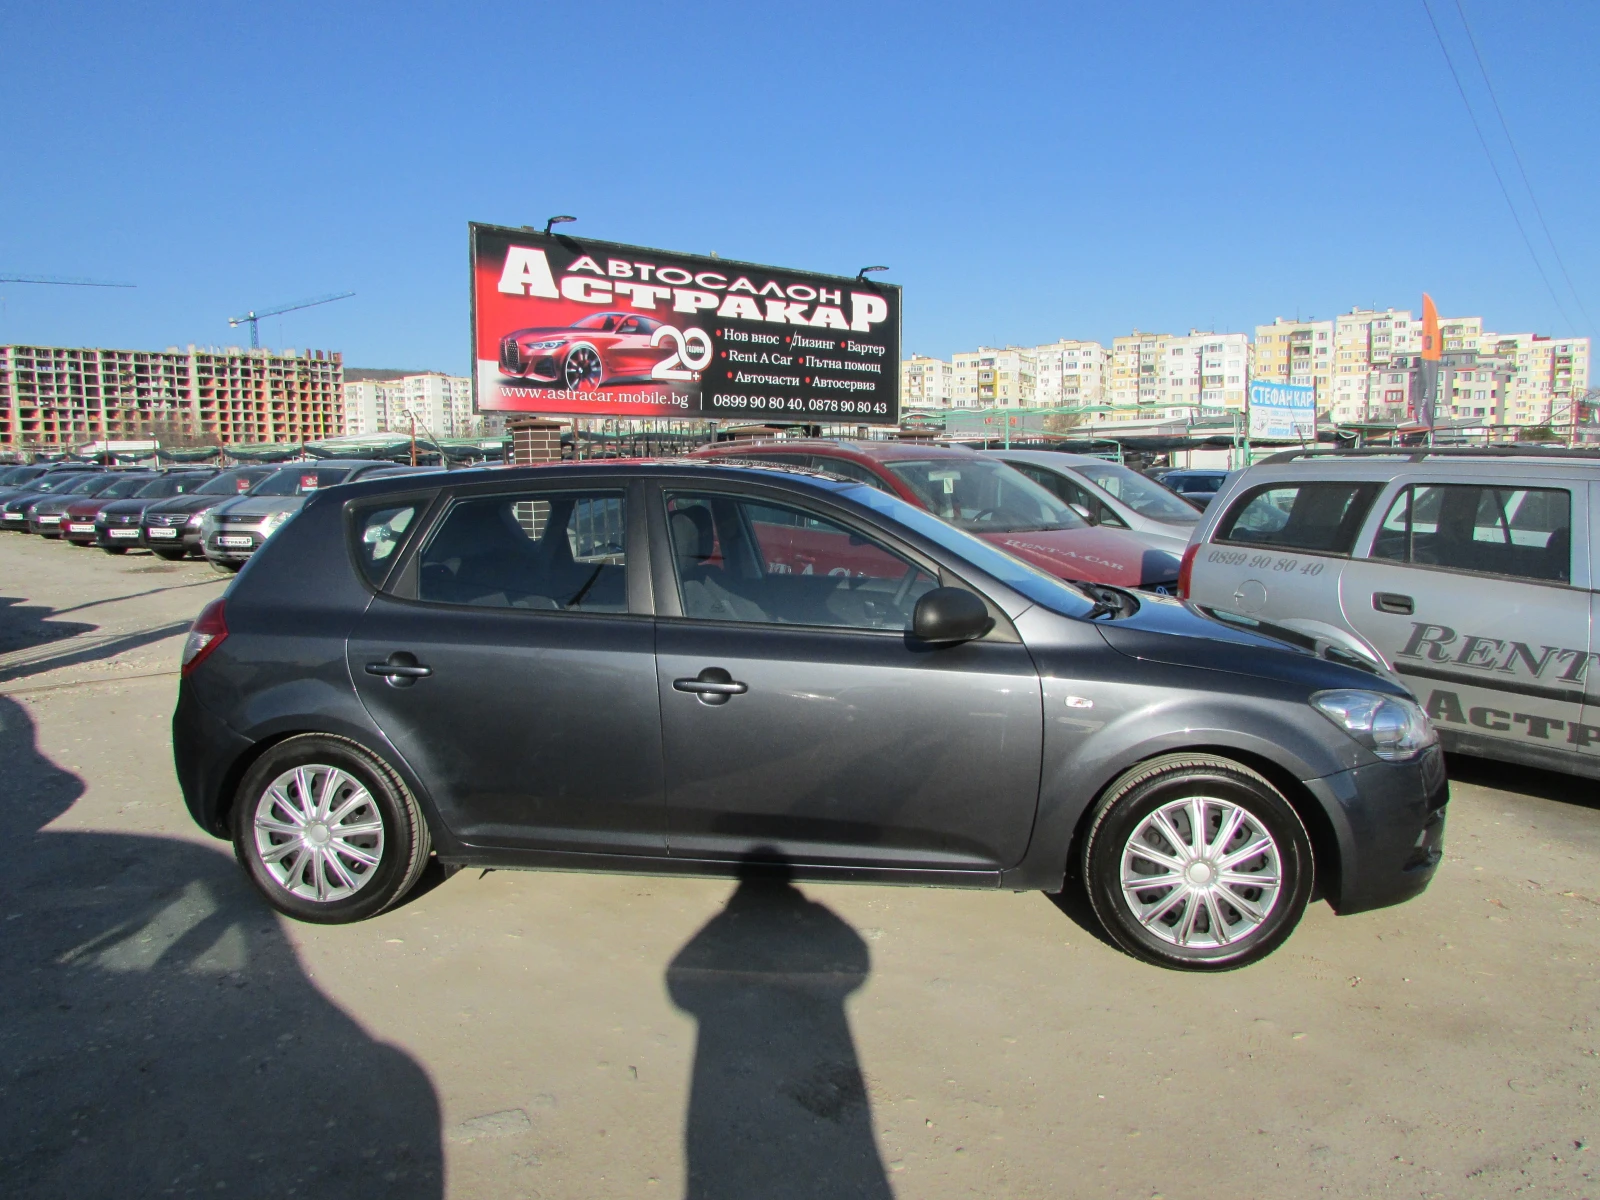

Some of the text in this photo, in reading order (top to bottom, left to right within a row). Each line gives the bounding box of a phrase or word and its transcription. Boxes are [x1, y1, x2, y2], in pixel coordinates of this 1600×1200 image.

[498, 245, 888, 332] АСТРАКАР
[566, 255, 841, 305] АВТОСАЛОН
[724, 328, 780, 345] Нов внос
[792, 335, 836, 350] Лизинг
[847, 340, 886, 356] Бартер
[729, 350, 793, 366] Rent A Car
[805, 355, 881, 374] Пътна помощ
[734, 371, 800, 387] Авточасти
[812, 376, 876, 393] Автосервиз
[500, 386, 689, 409] www.astracar.mobile.bg
[713, 394, 887, 414] 0899 90 80 40, 0878 90 80 43
[1003, 538, 1124, 571] RENT-A-CAR
[1207, 550, 1325, 577] 0899 90 80 40
[1396, 621, 1600, 685] RENT
